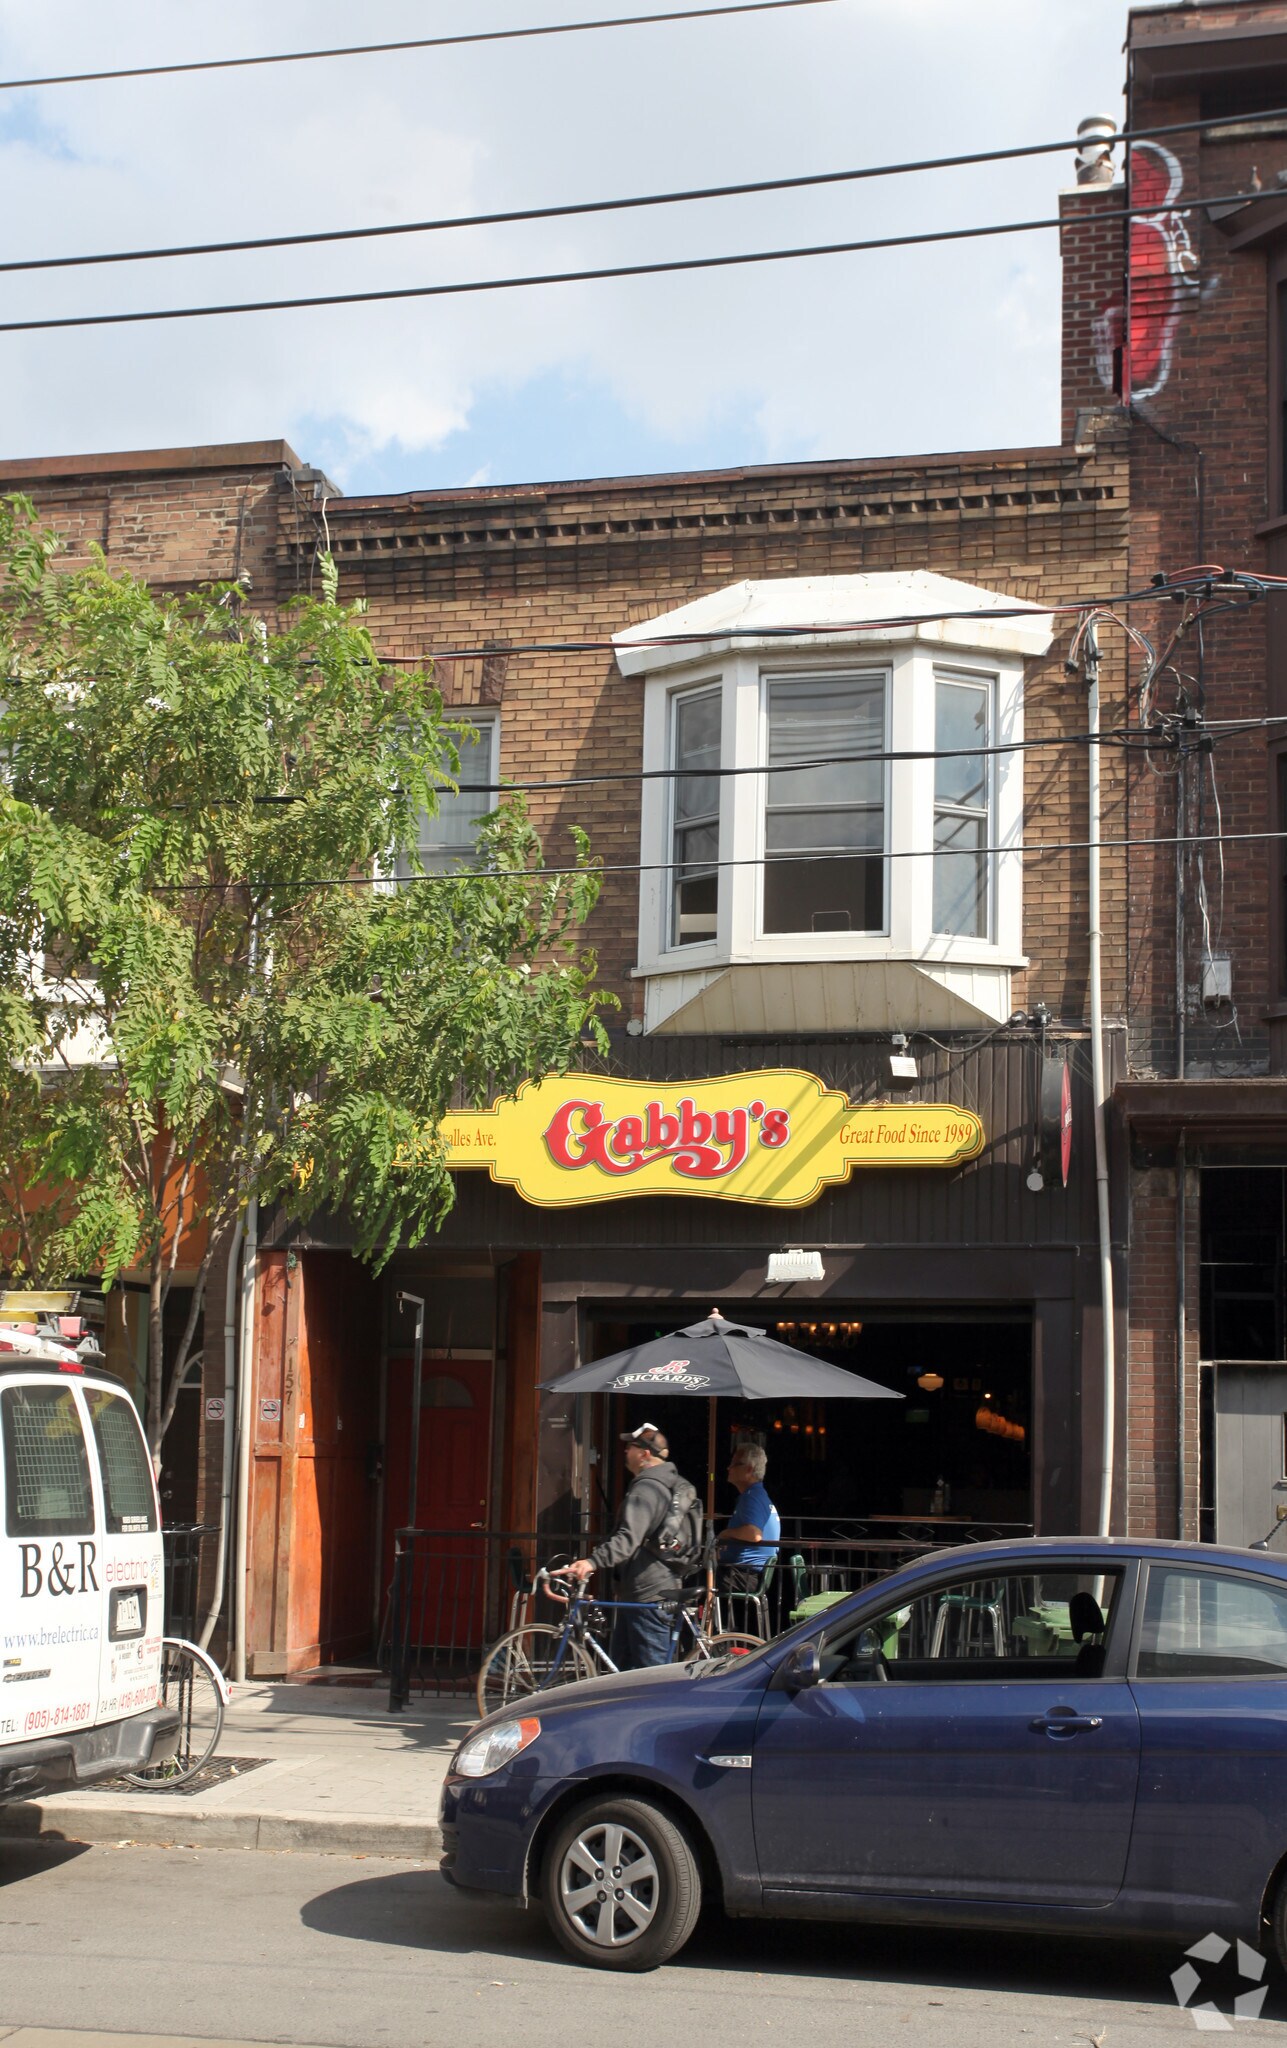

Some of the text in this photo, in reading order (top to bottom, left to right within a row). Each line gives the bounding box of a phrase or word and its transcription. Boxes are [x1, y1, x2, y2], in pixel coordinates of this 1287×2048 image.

[474, 1128, 497, 1147] Ave.
[544, 1098, 790, 1179] Gabby's
[839, 1123, 972, 1145] Great Food Since 1989
[623, 1373, 704, 1386] RICKARD'S
[18, 1541, 100, 1598] B&R
[106, 1556, 148, 1582] electric
[4, 1624, 99, 1649] www.brelectric.ca
[1, 1702, 91, 1734] TEL: (905)-814-1881
